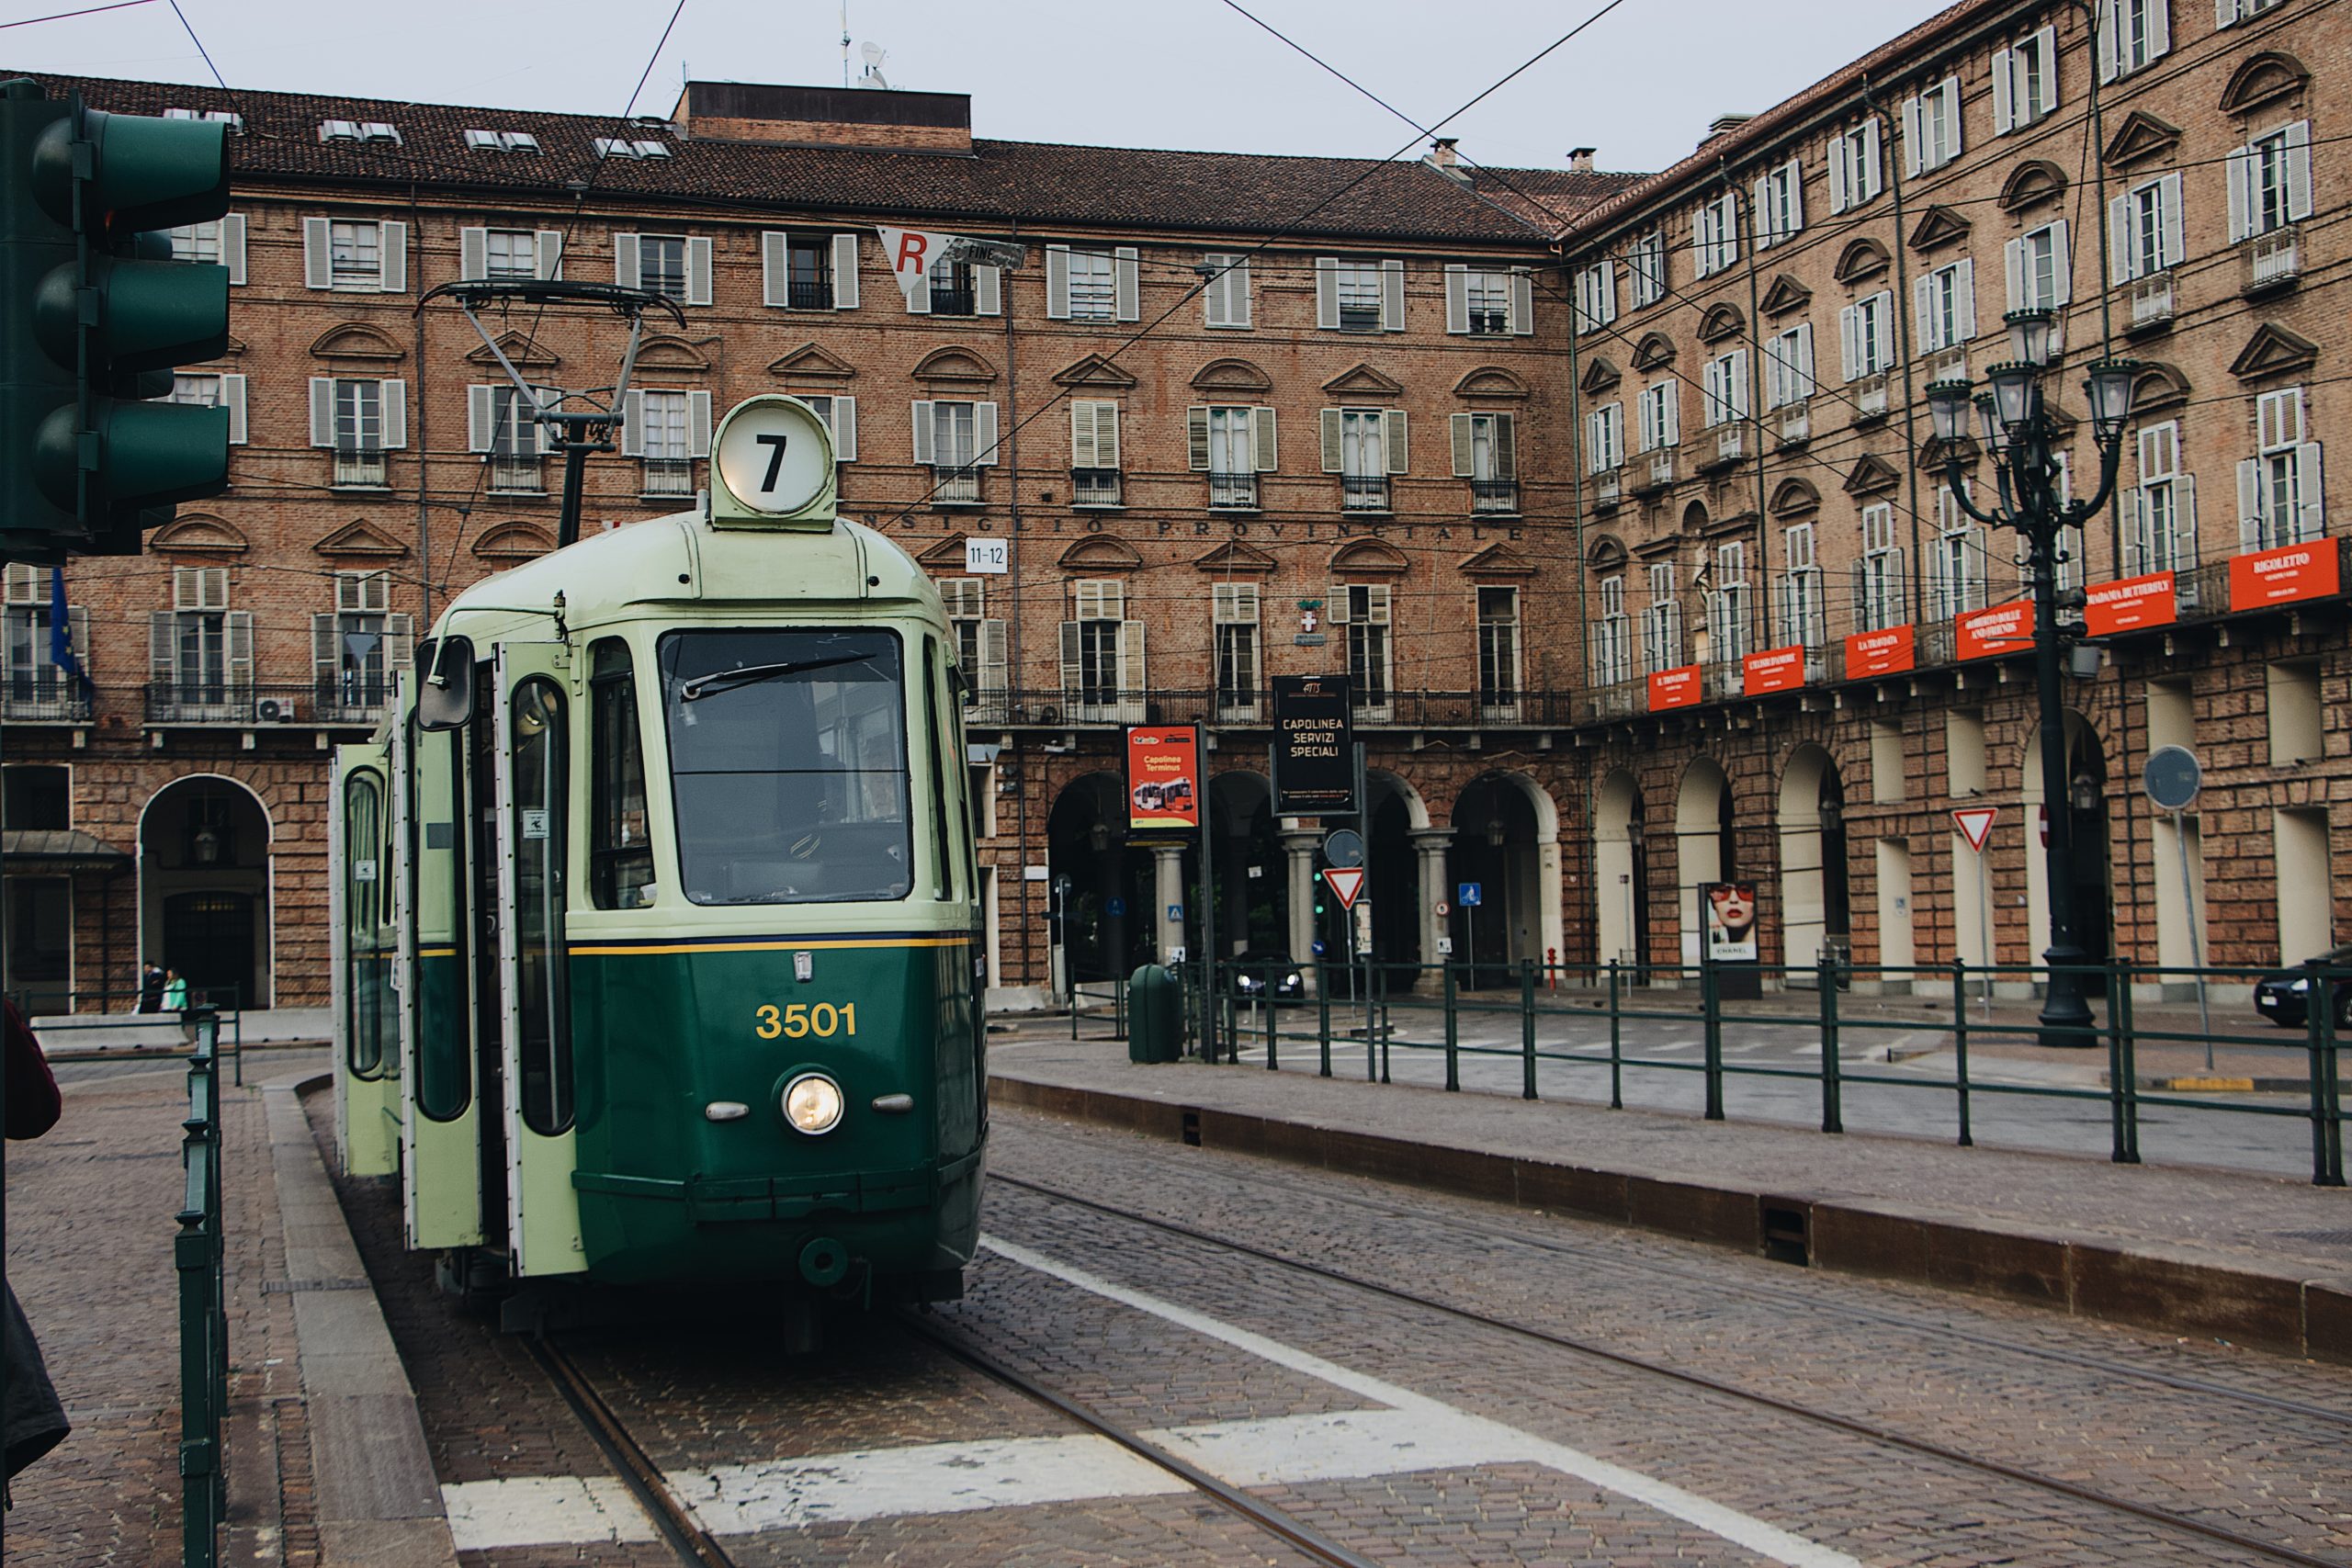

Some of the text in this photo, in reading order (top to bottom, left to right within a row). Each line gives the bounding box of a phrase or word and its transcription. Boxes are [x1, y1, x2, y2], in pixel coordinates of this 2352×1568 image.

[896, 232, 928, 275] R
[968, 245, 994, 261] FINE
[756, 434, 787, 493] 7
[1158, 521, 1523, 541] PROVINCIALE
[969, 547, 1004, 565] 11-12
[2254, 552, 2310, 574] RIGOLETTO
[1283, 718, 1344, 730] CAPOLINEA
[1294, 732, 1335, 744] SERVIZI
[1143, 755, 1182, 764] Capolinea
[1290, 746, 1339, 758] SPECIALI
[1146, 763, 1181, 773] Terminus
[755, 1001, 856, 1039] 3501
